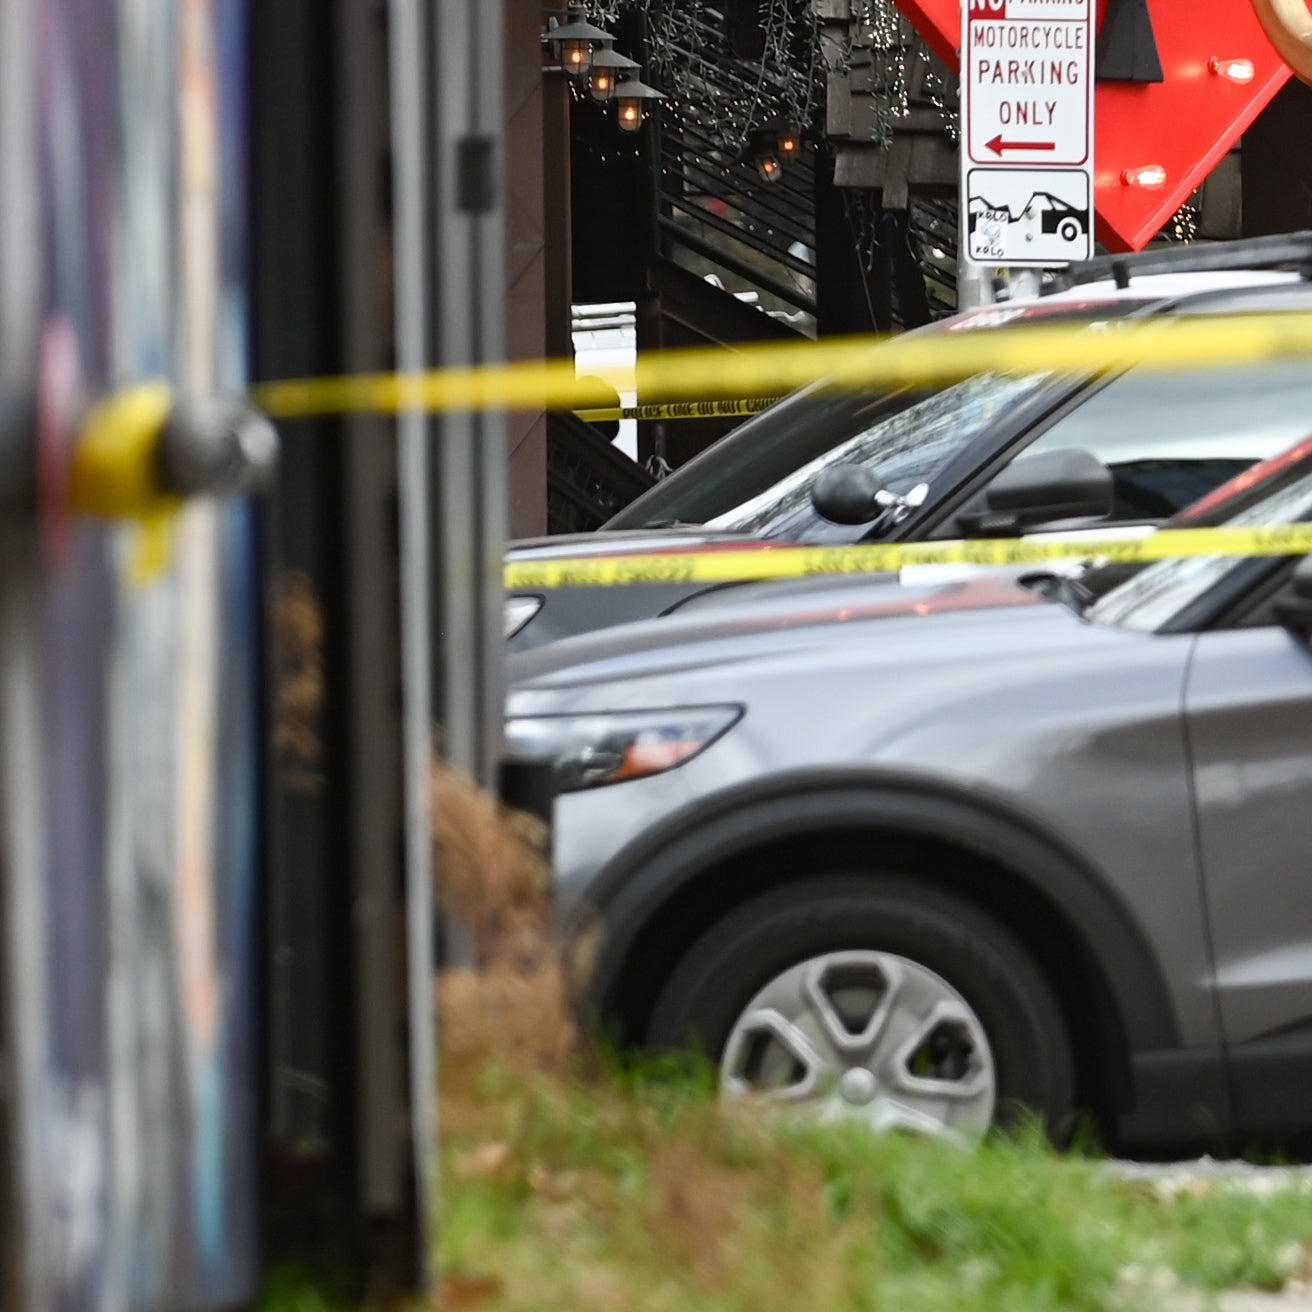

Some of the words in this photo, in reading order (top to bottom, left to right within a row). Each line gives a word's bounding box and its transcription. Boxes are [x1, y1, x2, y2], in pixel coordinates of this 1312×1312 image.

[974, 25, 1084, 49] MOTORCYCLE
[978, 60, 1079, 85] PARKING
[999, 101, 1058, 125] ONLY
